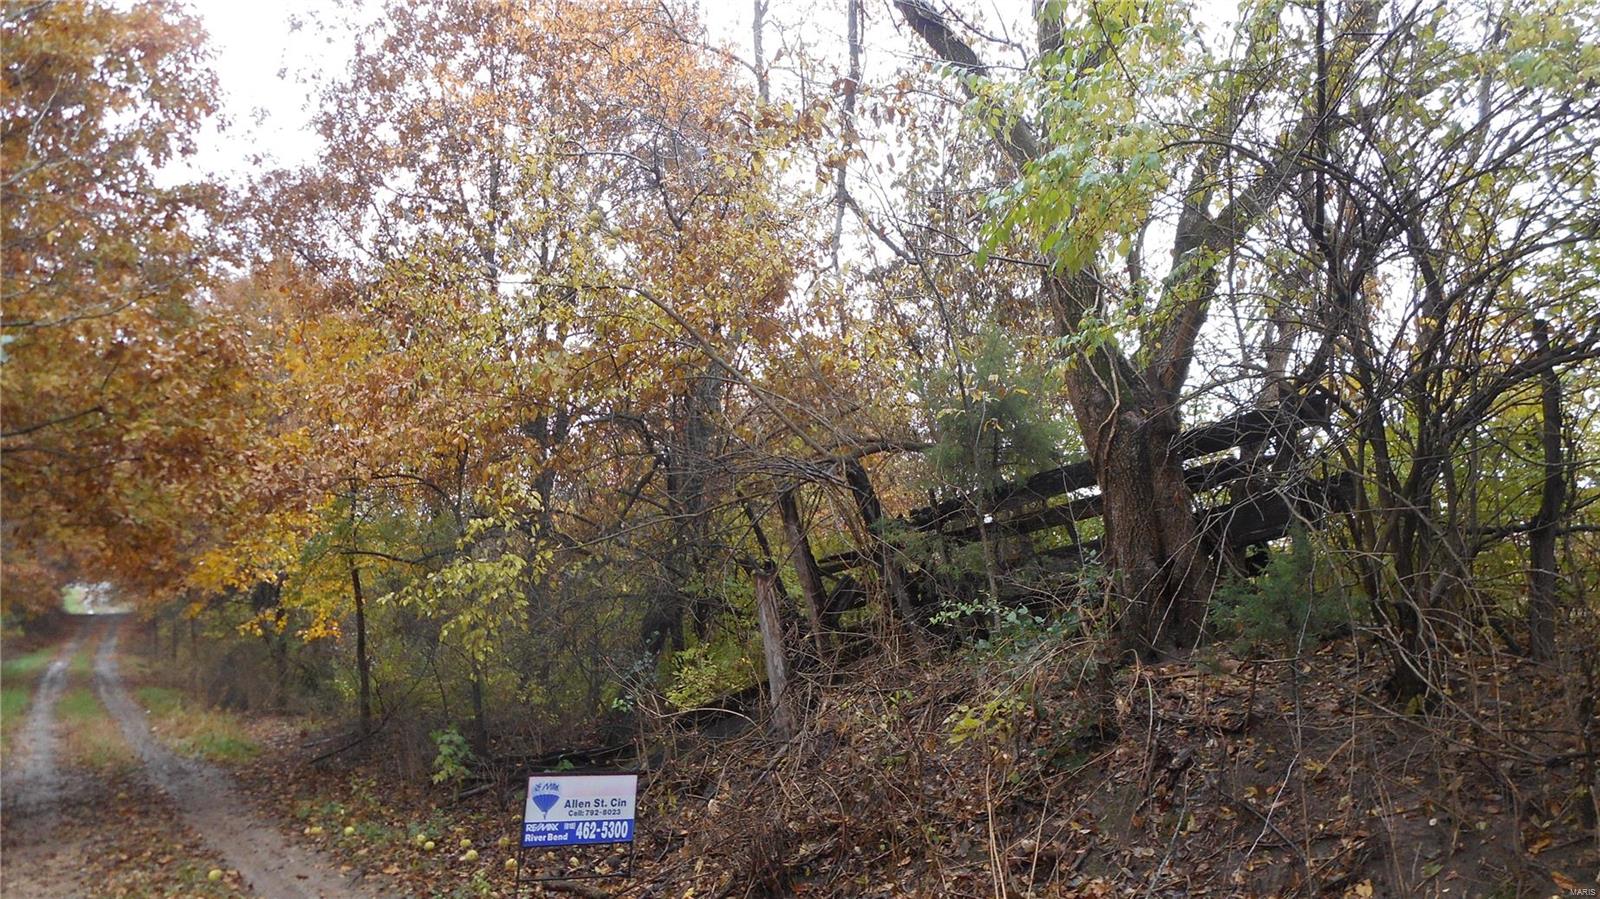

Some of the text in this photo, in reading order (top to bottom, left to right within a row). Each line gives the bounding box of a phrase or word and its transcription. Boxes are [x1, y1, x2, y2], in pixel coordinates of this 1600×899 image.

[564, 798, 627, 809] Allen St. Cin
[576, 821, 628, 839] 462-5300
[525, 833, 568, 842] River Bend
